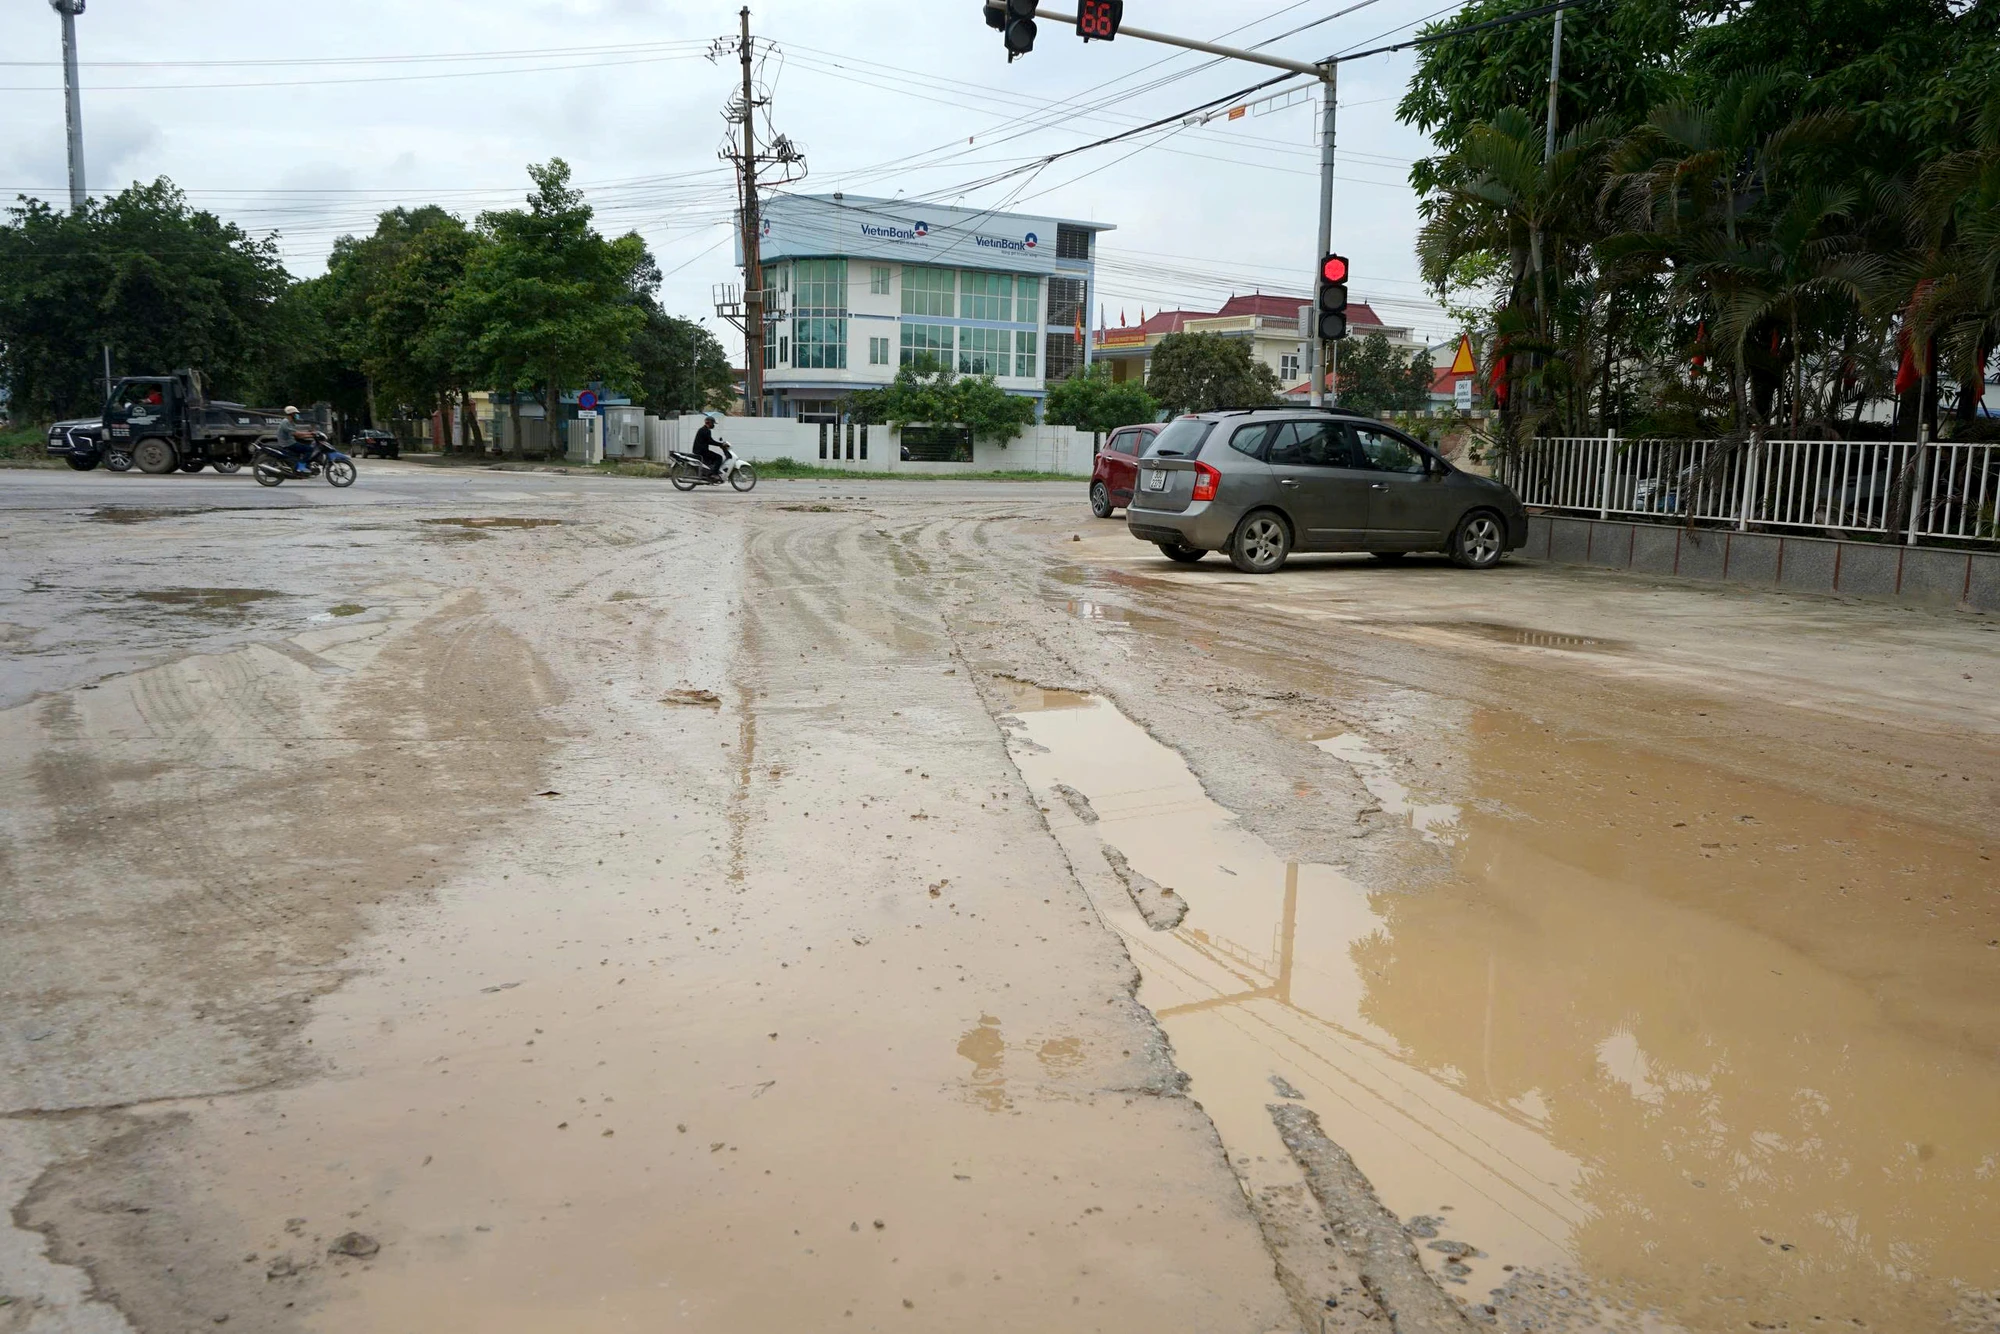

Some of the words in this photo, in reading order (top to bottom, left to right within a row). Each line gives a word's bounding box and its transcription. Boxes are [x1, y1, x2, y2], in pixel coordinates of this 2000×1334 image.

[1081, 1, 1111, 35] 66
[861, 224, 916, 239] VietinBank
[975, 236, 1026, 250] VietinBank
